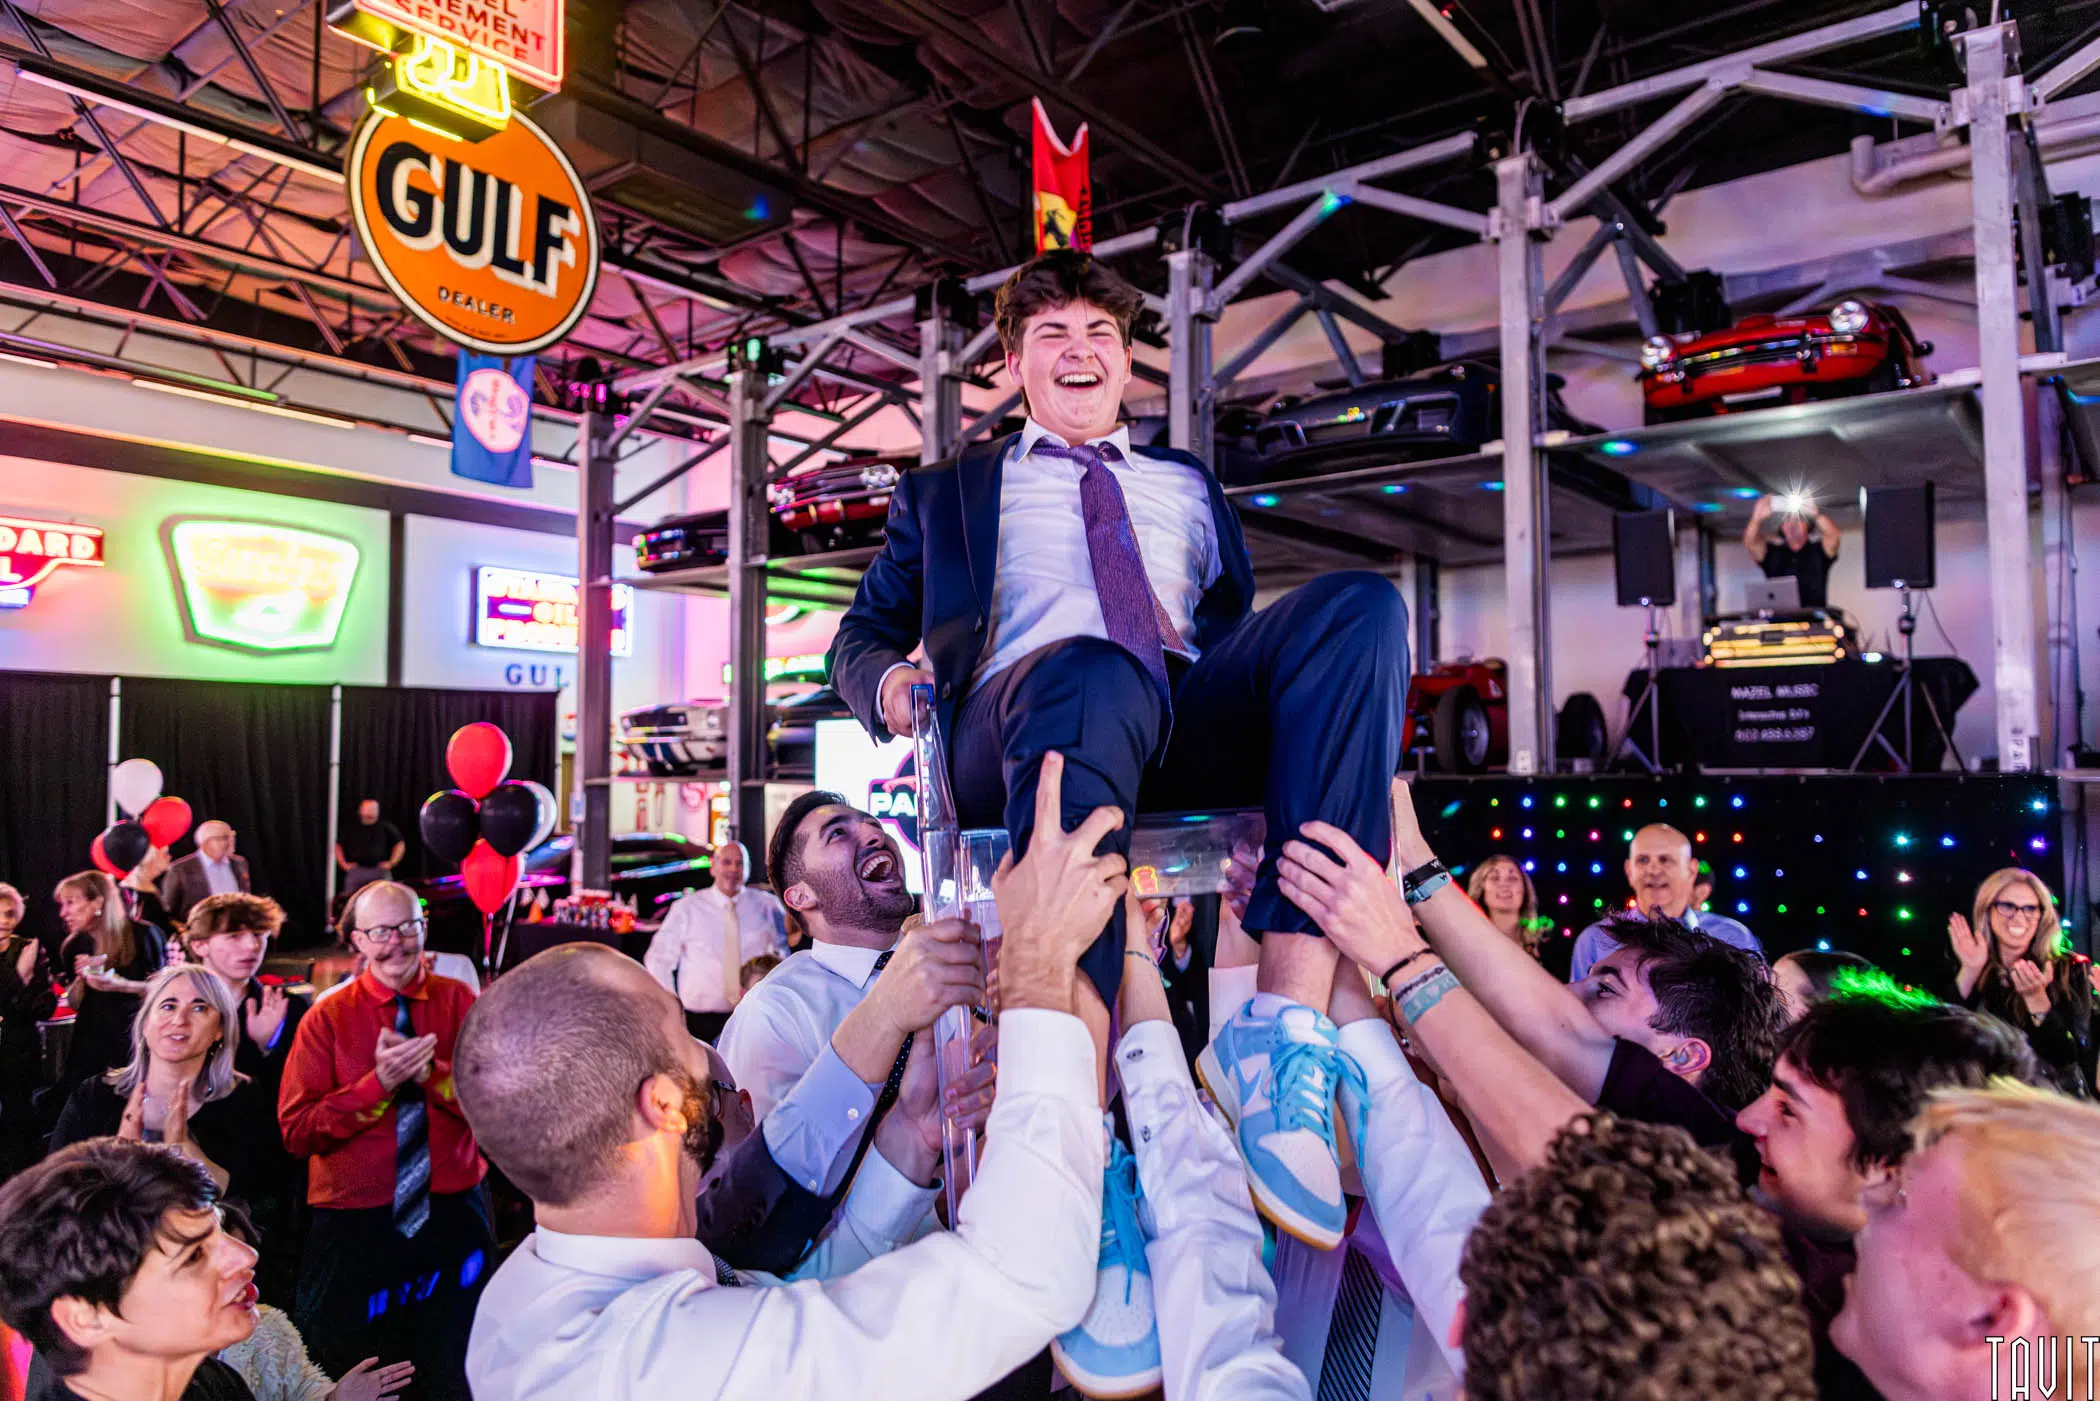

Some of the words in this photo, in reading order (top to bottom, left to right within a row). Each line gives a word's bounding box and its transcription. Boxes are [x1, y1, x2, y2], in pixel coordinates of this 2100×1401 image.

[375, 140, 580, 298] GULF
[438, 285, 516, 325] DEALER
[505, 663, 570, 689] GUL
[871, 792, 918, 817] PA
